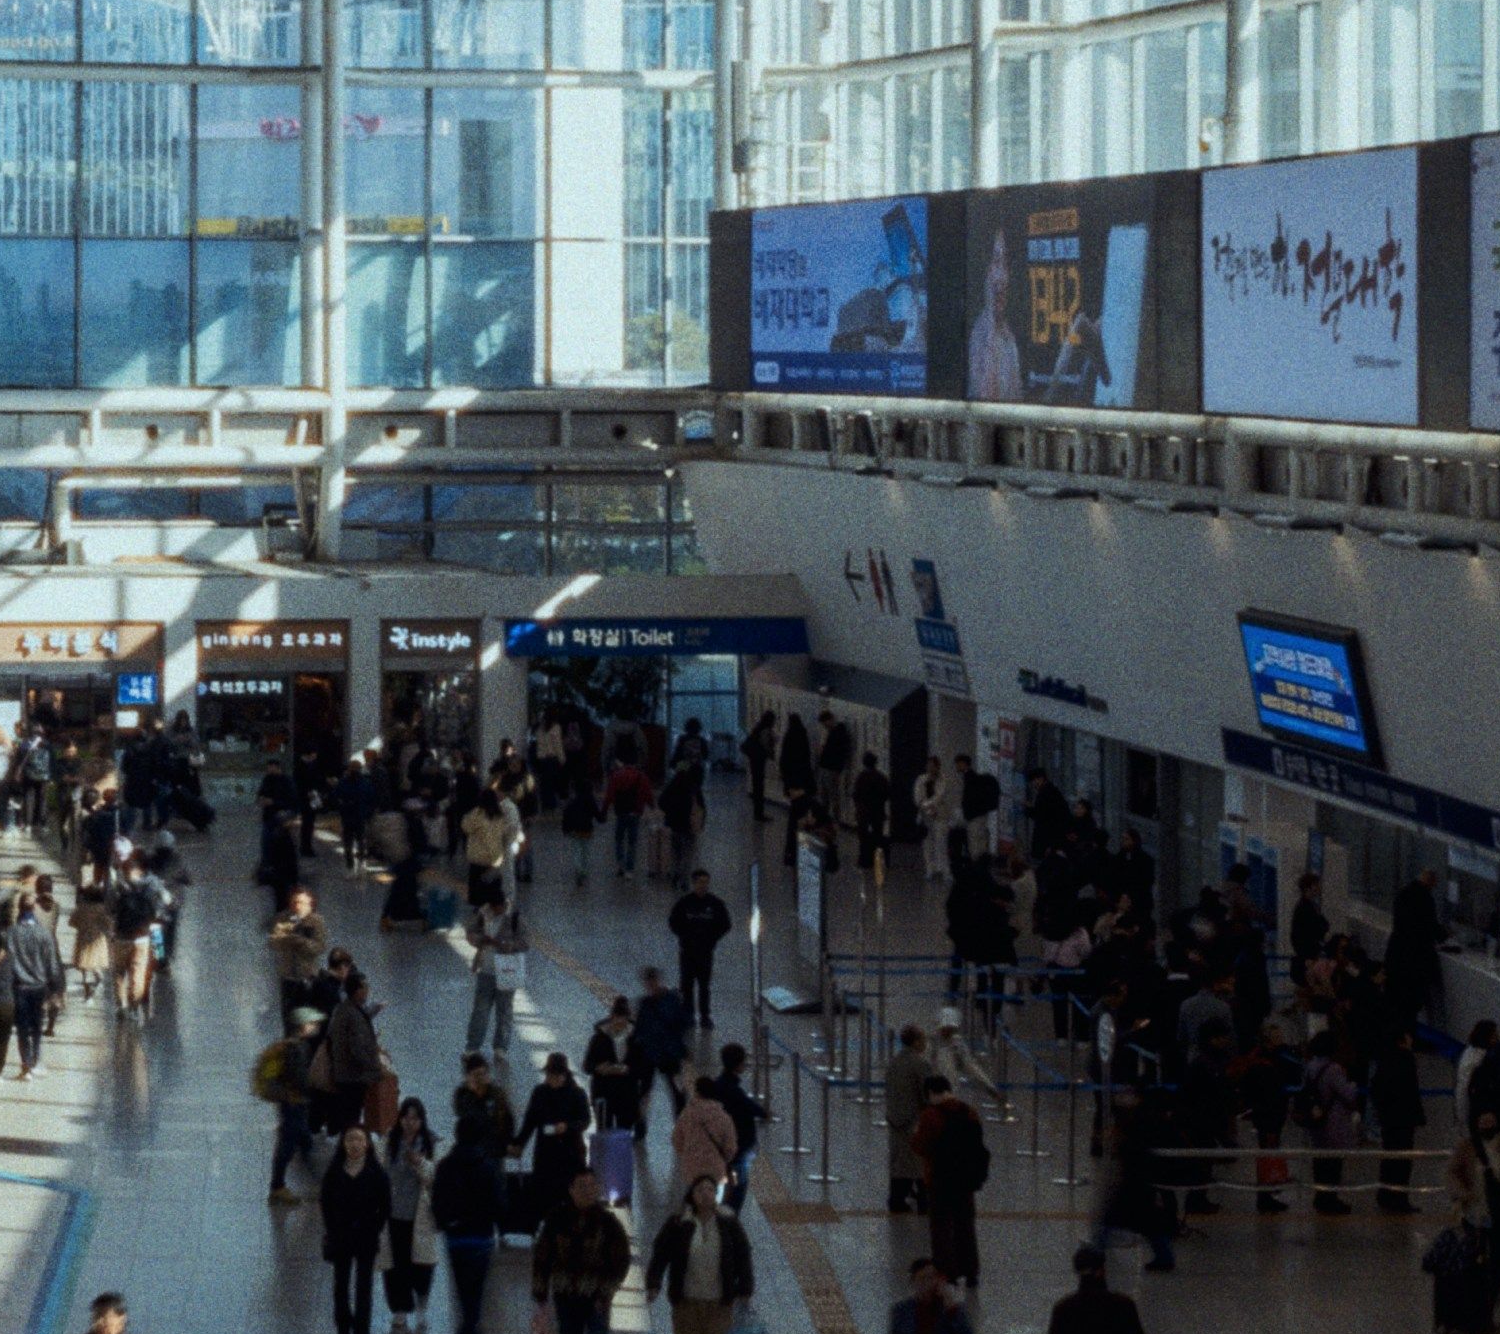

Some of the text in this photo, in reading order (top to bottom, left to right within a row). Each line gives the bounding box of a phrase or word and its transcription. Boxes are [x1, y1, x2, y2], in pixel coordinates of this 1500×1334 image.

[202, 632, 343, 649] ginseng 호두과자
[571, 628, 620, 648] 화장실
[629, 628, 675, 647] Toilet
